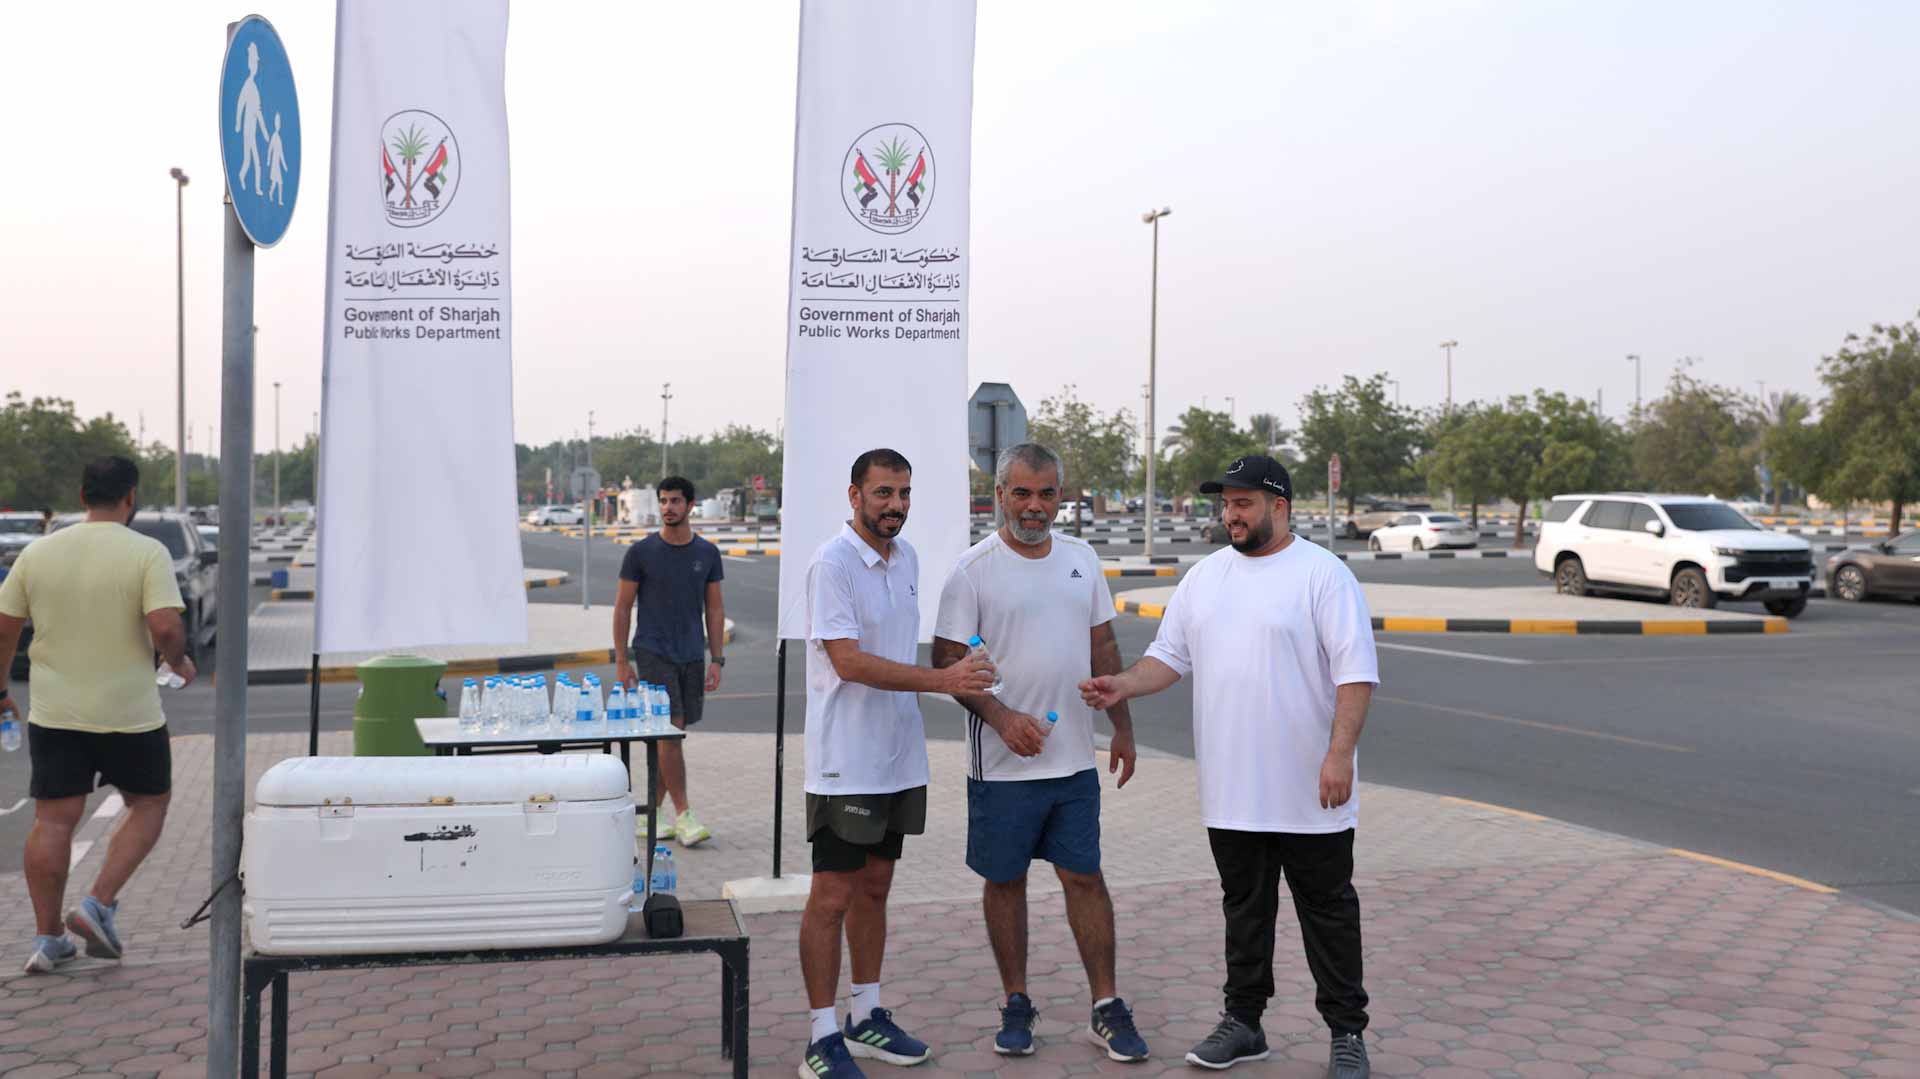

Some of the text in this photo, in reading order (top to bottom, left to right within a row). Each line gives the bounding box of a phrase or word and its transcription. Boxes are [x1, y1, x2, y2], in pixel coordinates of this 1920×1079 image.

[802, 247, 887, 267] الشارقة
[801, 272, 864, 288] العامة
[344, 306, 500, 325] Goveent of Sharjah
[800, 307, 960, 326] Government of Sharjah
[416, 325, 500, 341] Department
[799, 325, 960, 342] Public Works Department
